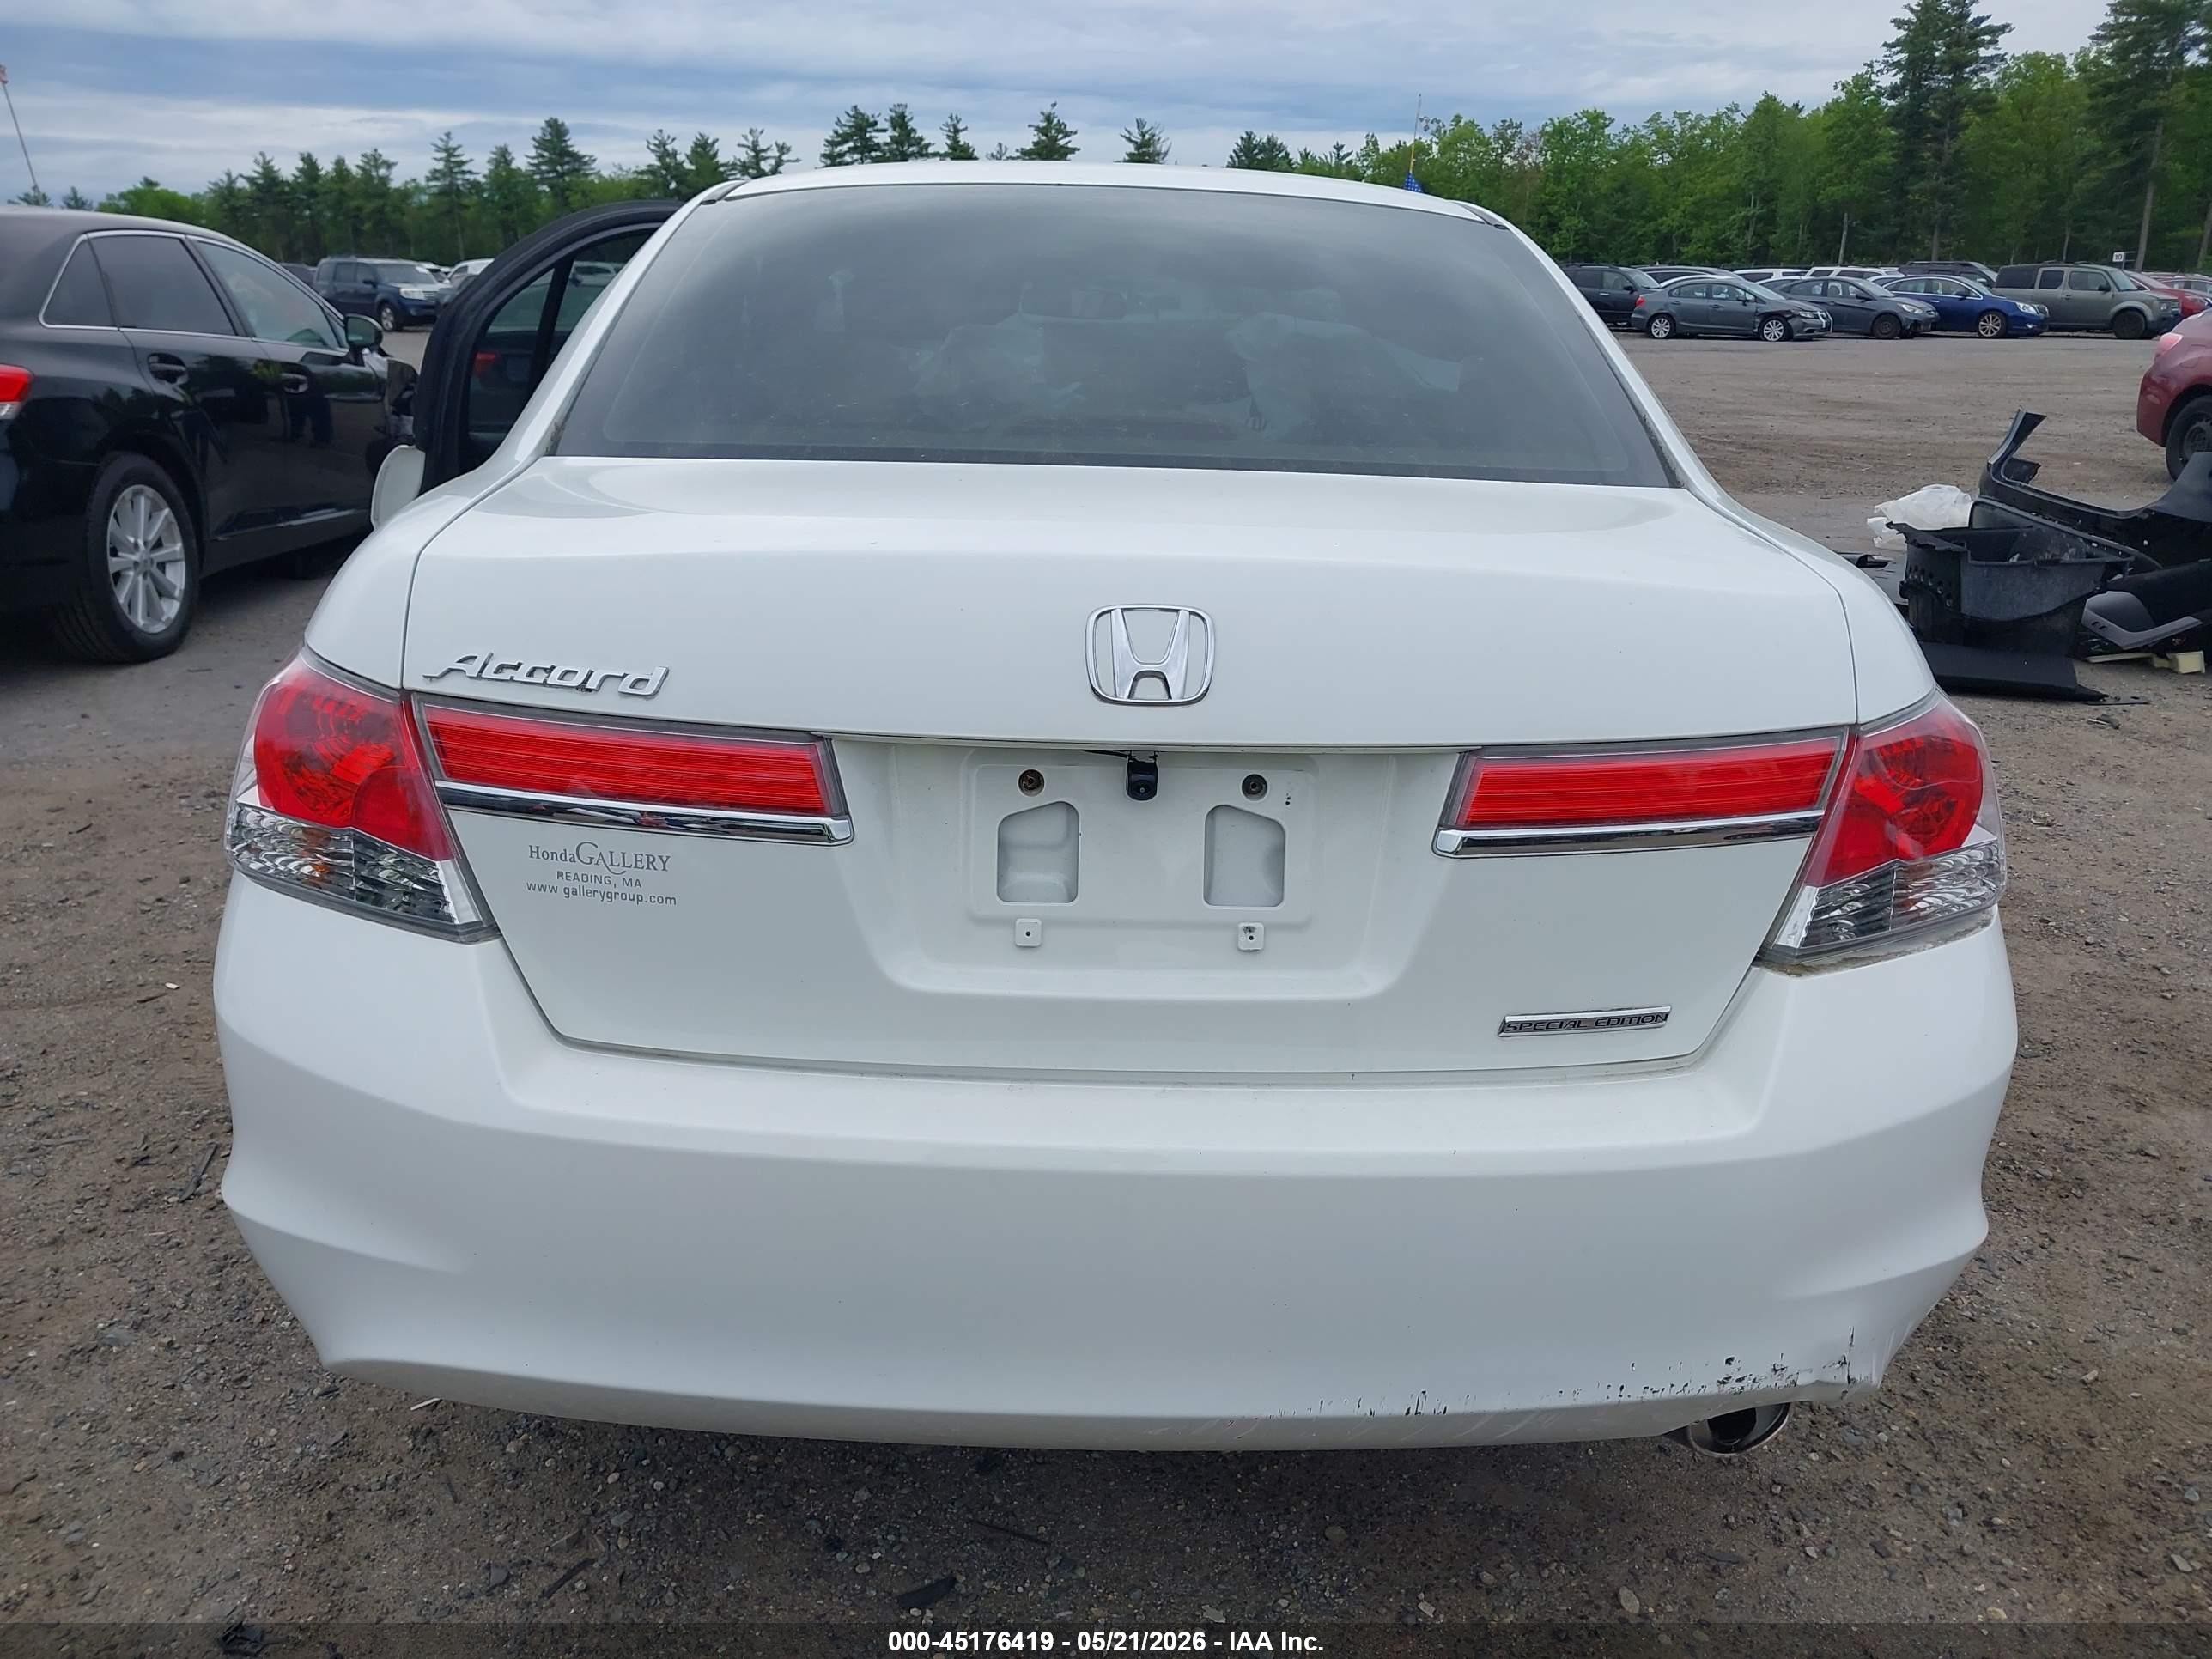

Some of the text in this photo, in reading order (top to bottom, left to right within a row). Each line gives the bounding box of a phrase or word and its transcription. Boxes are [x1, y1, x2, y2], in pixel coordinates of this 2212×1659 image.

[422, 652, 670, 697] Accord
[556, 870, 642, 889] READING, MA
[1504, 1013, 1669, 1032] SPECIAL EDITION
